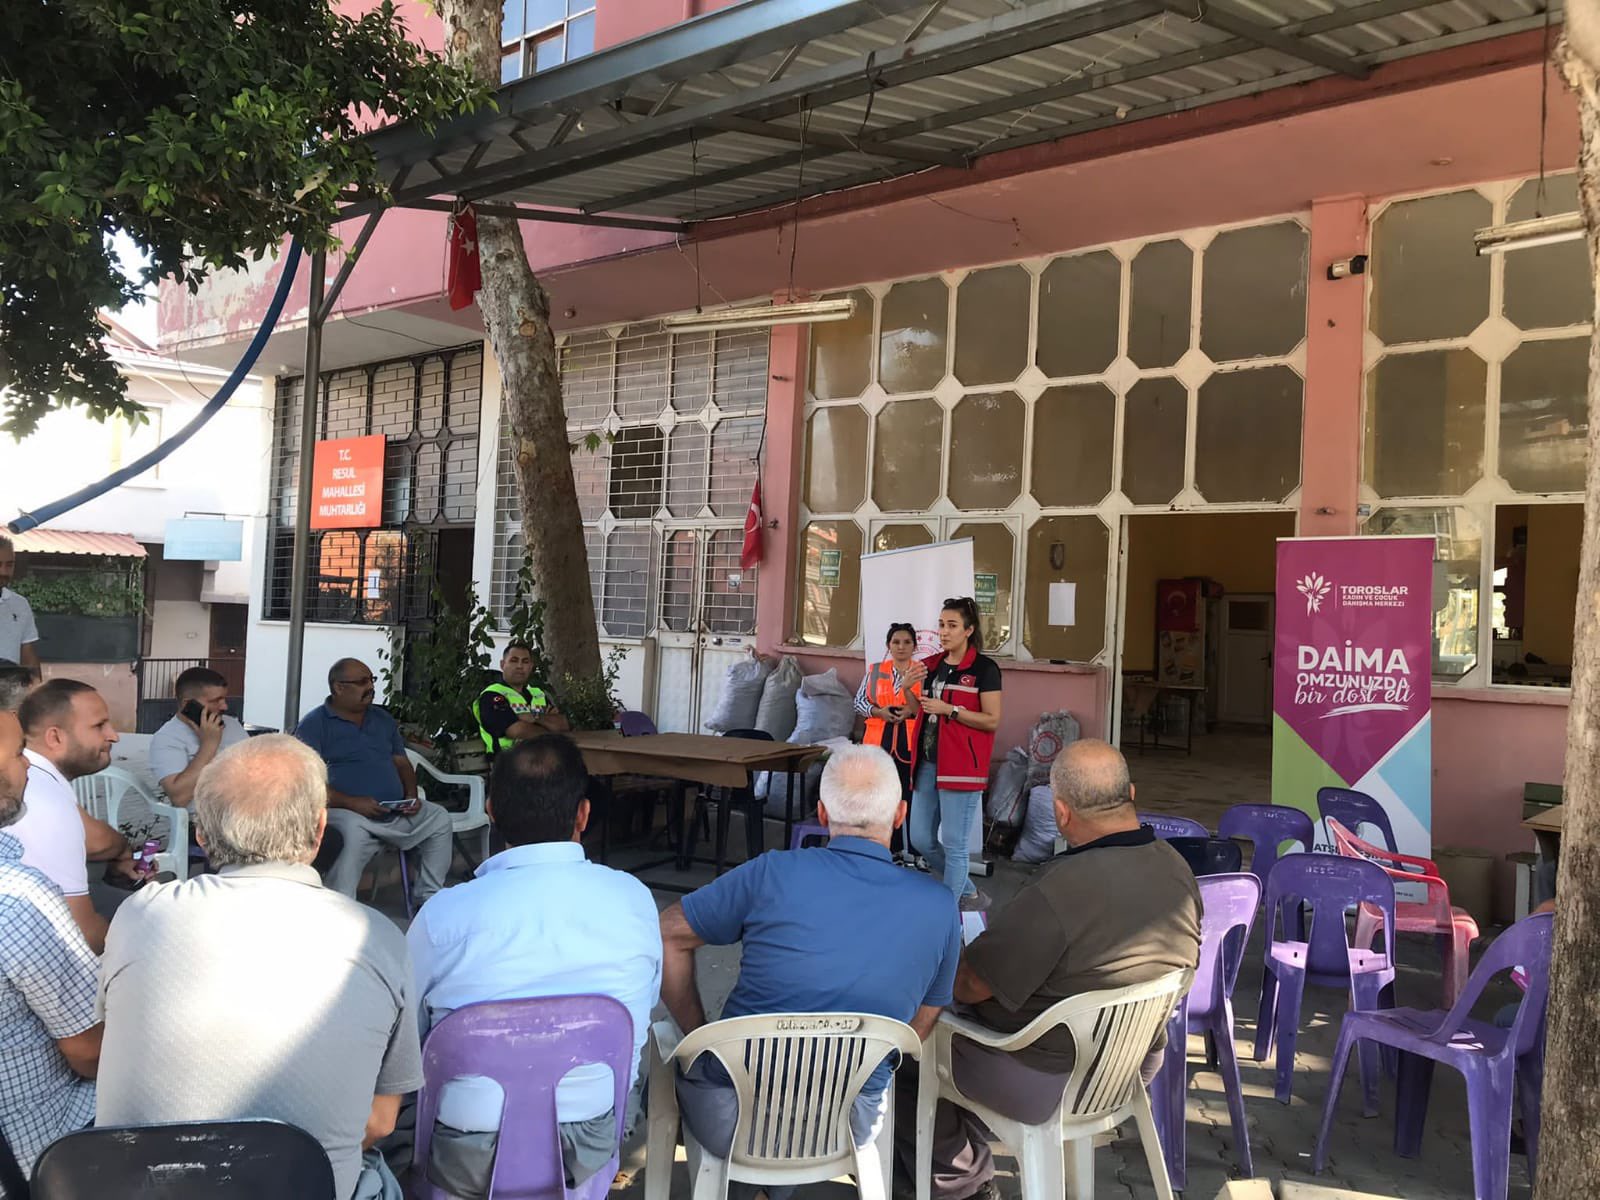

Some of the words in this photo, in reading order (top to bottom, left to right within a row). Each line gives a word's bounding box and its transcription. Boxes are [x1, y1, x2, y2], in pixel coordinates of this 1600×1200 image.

[332, 467, 357, 480] RESUL
[322, 481, 366, 498] MAHALLESİ
[319, 501, 366, 517] MUHTARLIĞI
[1340, 585, 1408, 595] TOROSLAR
[1298, 640, 1410, 674] DAİMA
[1296, 673, 1409, 691] OMZUNUZDA
[1295, 682, 1327, 704] bir
[1332, 680, 1376, 704] dost
[1384, 682, 1415, 703] eli
